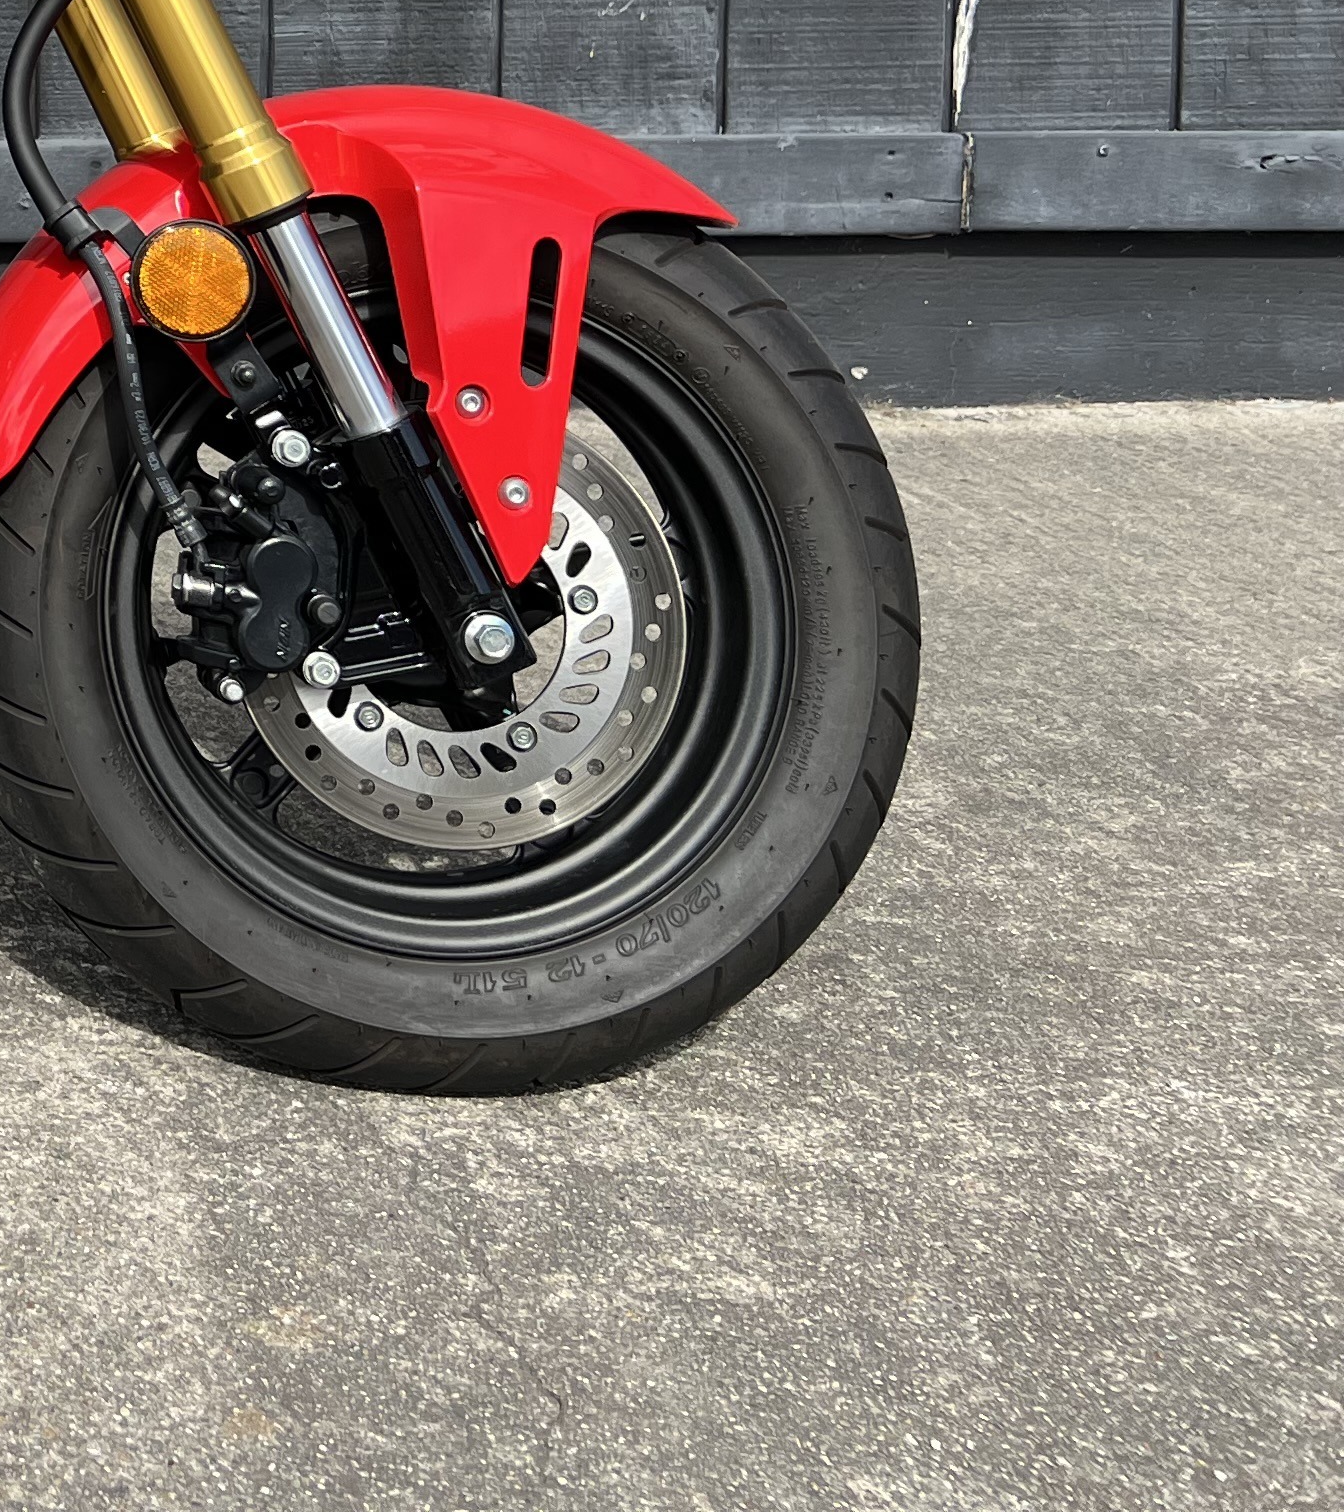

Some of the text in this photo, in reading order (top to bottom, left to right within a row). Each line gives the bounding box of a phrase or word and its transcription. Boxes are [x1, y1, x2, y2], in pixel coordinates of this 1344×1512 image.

[616, 878, 724, 958] 120/70
[453, 969, 529, 995] 51L
[545, 954, 586, 984] 12
